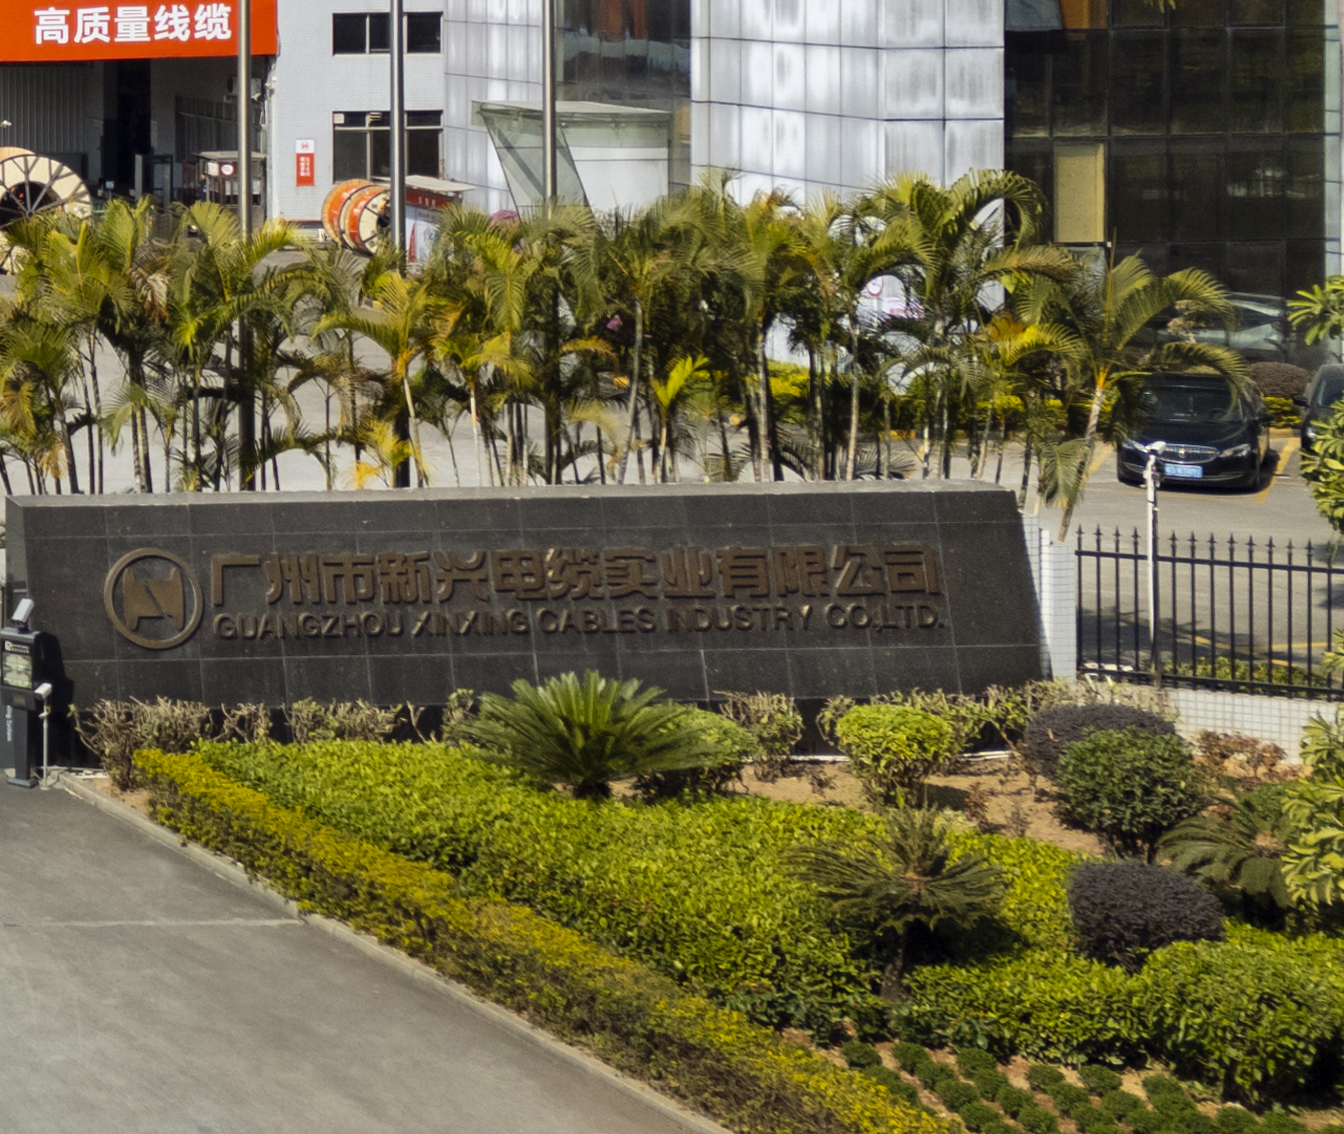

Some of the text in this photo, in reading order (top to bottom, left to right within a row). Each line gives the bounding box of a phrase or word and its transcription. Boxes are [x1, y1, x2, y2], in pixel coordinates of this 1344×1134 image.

[33, 3, 232, 45] 高质量线缆
[210, 543, 944, 607] 广州市新兴电缆实业有限公司
[212, 611, 403, 640] GUANGZHOU
[411, 609, 530, 638] XINXING
[537, 608, 656, 634] CABLES
[667, 605, 813, 632] INDUSTRY
